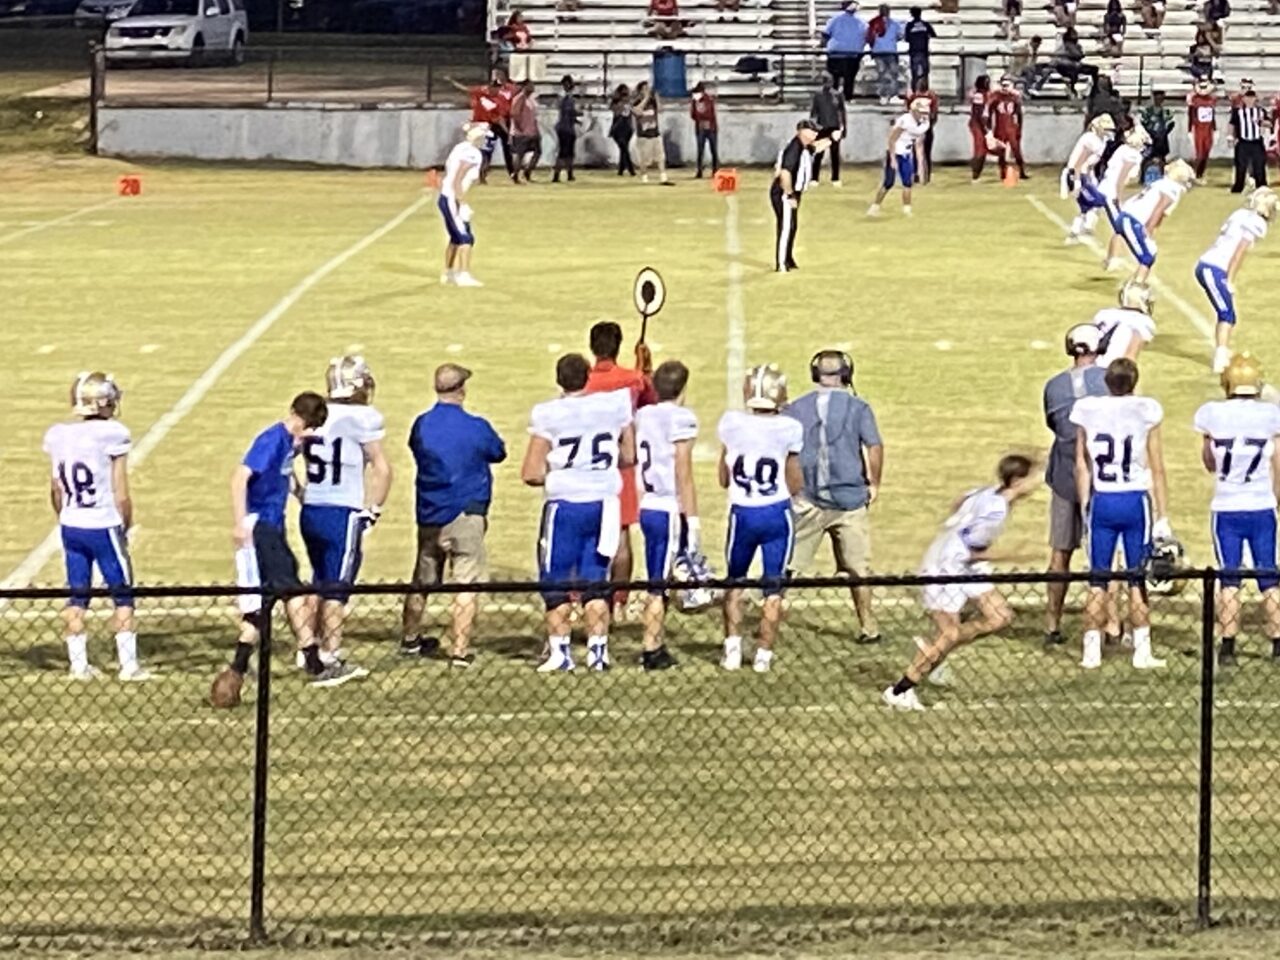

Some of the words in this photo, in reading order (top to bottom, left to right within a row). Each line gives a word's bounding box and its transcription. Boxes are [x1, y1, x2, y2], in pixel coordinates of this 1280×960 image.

[119, 178, 141, 195] 20
[302, 435, 343, 486] 51
[557, 432, 614, 471] 75
[1093, 433, 1133, 482] 21
[1214, 437, 1269, 483] 77
